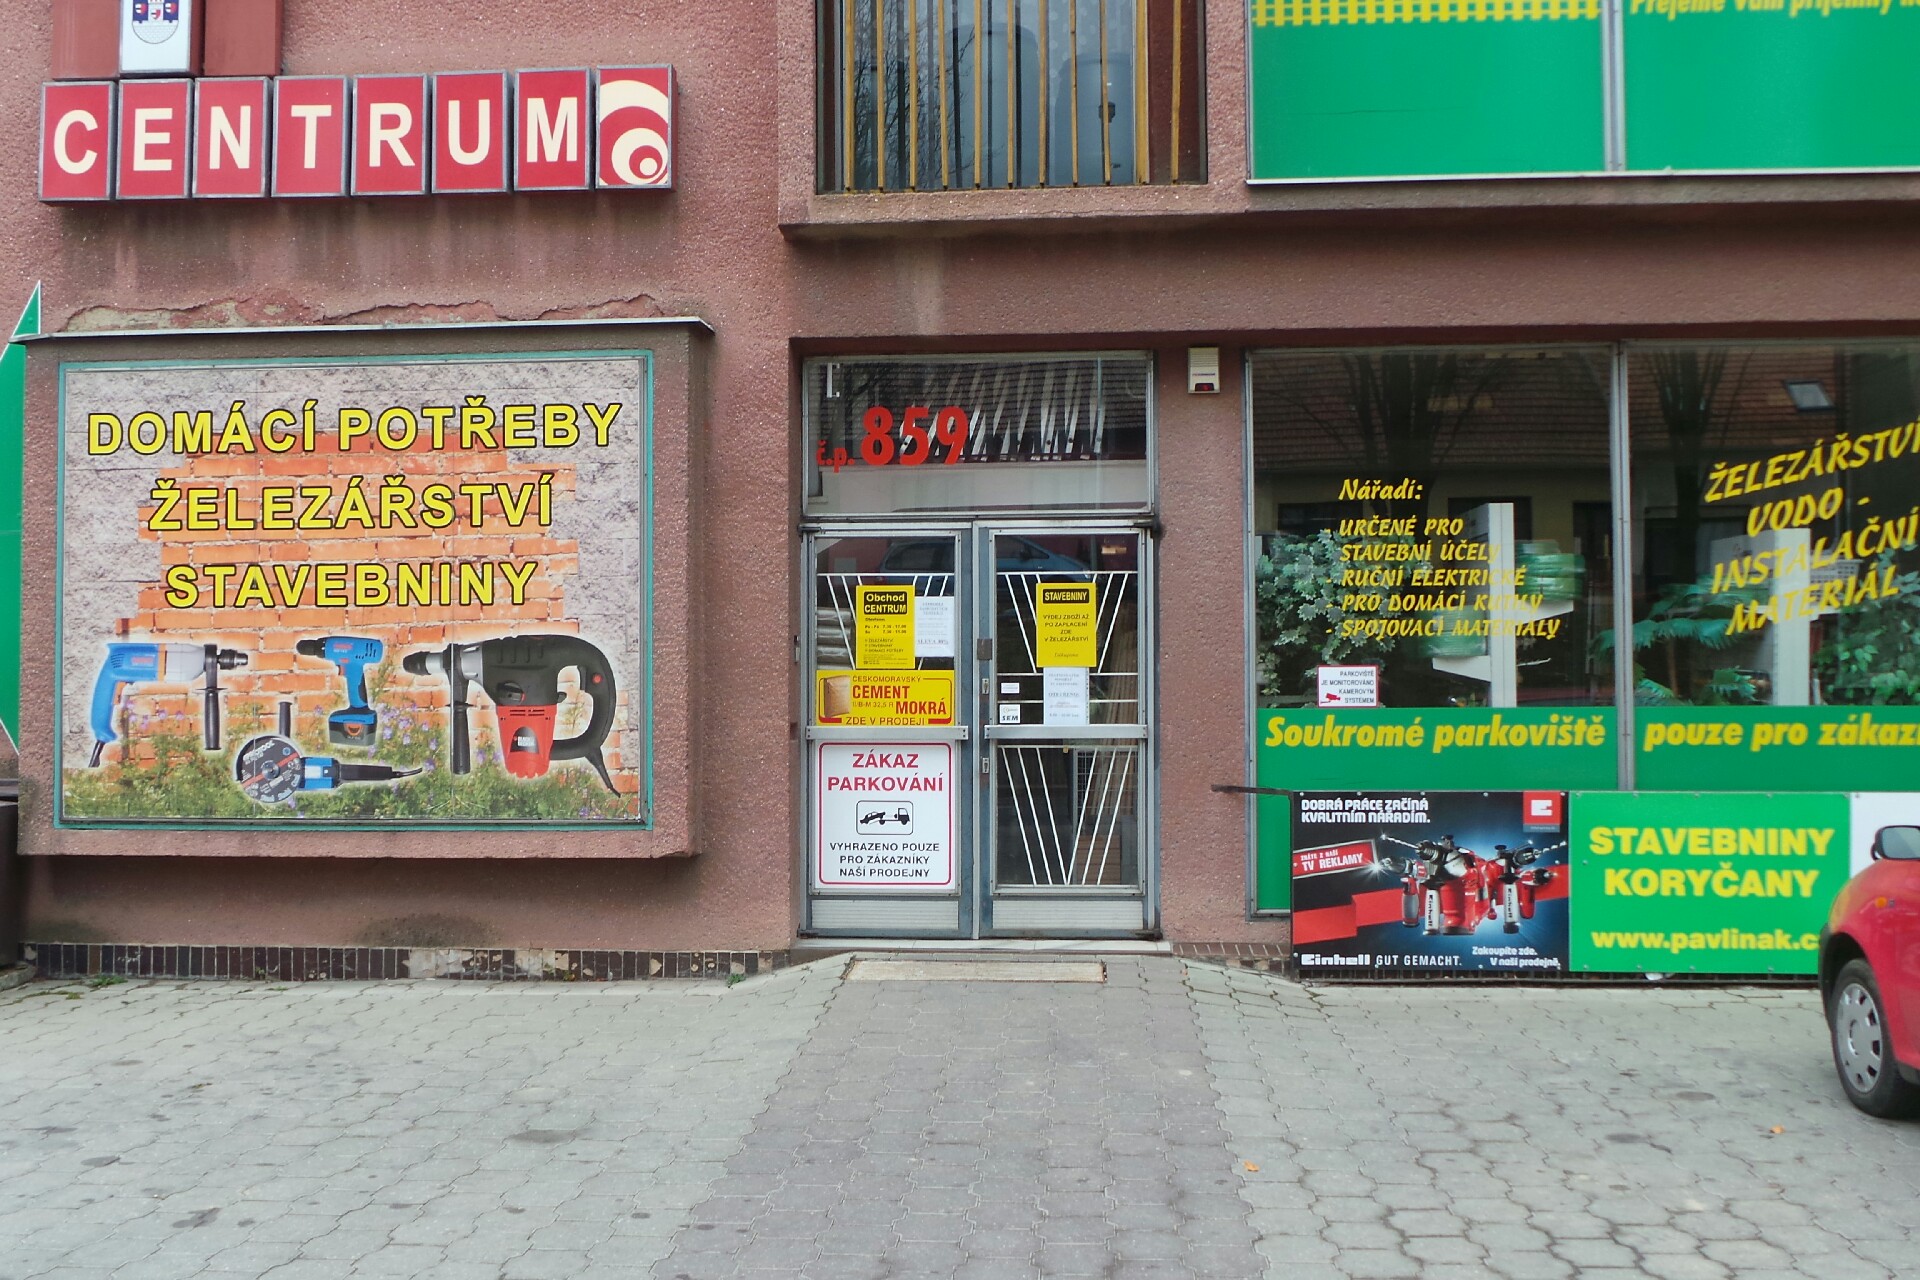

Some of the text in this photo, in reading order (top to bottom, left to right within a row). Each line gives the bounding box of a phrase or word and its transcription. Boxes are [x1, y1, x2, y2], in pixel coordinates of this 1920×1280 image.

[53, 96, 579, 175] CENTRUM
[88, 395, 622, 455] DOMÁCÍ POTŘEBY
[860, 405, 969, 466] 859
[1338, 478, 1422, 501] Nářadí:
[148, 473, 553, 531] ŽELEZÁŘSTVÍ
[1747, 487, 1844, 537] VODO
[1339, 515, 1418, 536] URČENÉ
[1424, 518, 1464, 536] PRO
[1339, 539, 1501, 564] STAVEBNÍ ÚČELY
[1711, 506, 1919, 594] INSTALAČNÍ
[166, 561, 537, 608] STAVEBNINY
[1341, 564, 1404, 587] RUČNÍ
[1411, 564, 1527, 587] ELEKTRICKÉ
[866, 593, 905, 602] Obchod
[1044, 591, 1088, 601] STAVEBNINY
[1341, 594, 1381, 612] PRO
[1387, 591, 1467, 612] DOMÁCÍ
[1725, 562, 1900, 636] MATERIÁL
[864, 604, 906, 613] CENTRUM
[1341, 615, 1445, 641] SPOJOVACÍ
[852, 685, 910, 699] CEMENT
[895, 697, 947, 715] MOKRÁ
[845, 717, 925, 726] ZDE V PRODEJI
[1265, 712, 1920, 753] Soukromé parkoviště pouze pro zákaz
[852, 748, 918, 769] ZÁKAZ
[827, 772, 943, 792] PARKOVÁNÍ
[1301, 797, 1429, 811] DOBRÁ PRÁCE ZAČÍNÁ
[1301, 810, 1431, 823] KVALITNÍM NÁŘADÍM.
[829, 842, 940, 852] VYHRAZENO POUZE
[1589, 826, 1835, 856] STAVEBNINY
[839, 853, 930, 865] PRO ZÁKAZNÍKY
[1302, 853, 1364, 872] TV REKLAMY
[839, 865, 930, 877] NAŠÍ PRODEJNY
[1604, 861, 1821, 898] KORYČANY
[1518, 946, 1538, 956] zde.
[1591, 928, 1821, 954] www.pavlinak.c
[1301, 953, 1463, 966] Einhell GUT GEMACHT.
[1489, 957, 1498, 966] V
